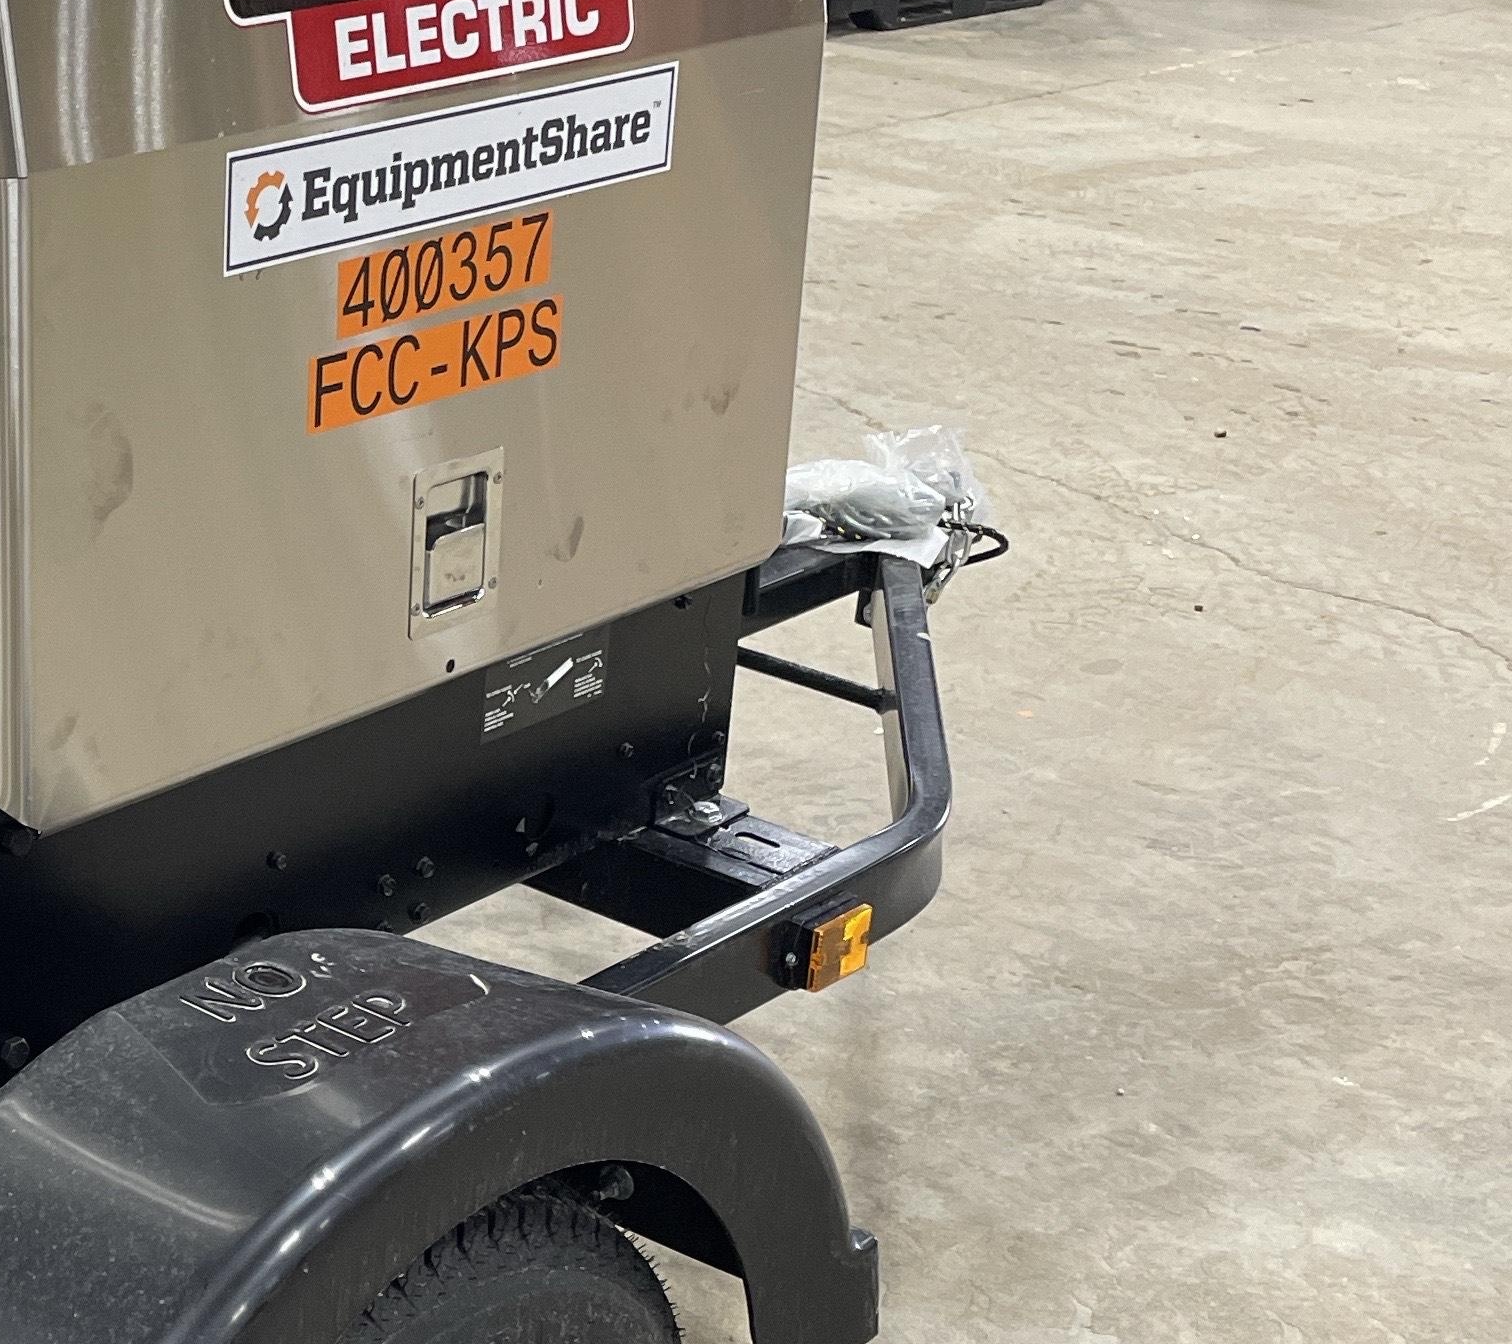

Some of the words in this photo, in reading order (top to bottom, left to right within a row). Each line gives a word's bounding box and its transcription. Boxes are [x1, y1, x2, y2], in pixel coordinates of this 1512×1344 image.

[301, 108, 652, 224] EquipmentShare
[342, 211, 551, 328] 400357
[313, 297, 560, 429] FCC-KPS
[179, 960, 307, 1024] NO
[245, 989, 413, 1081] STEP
